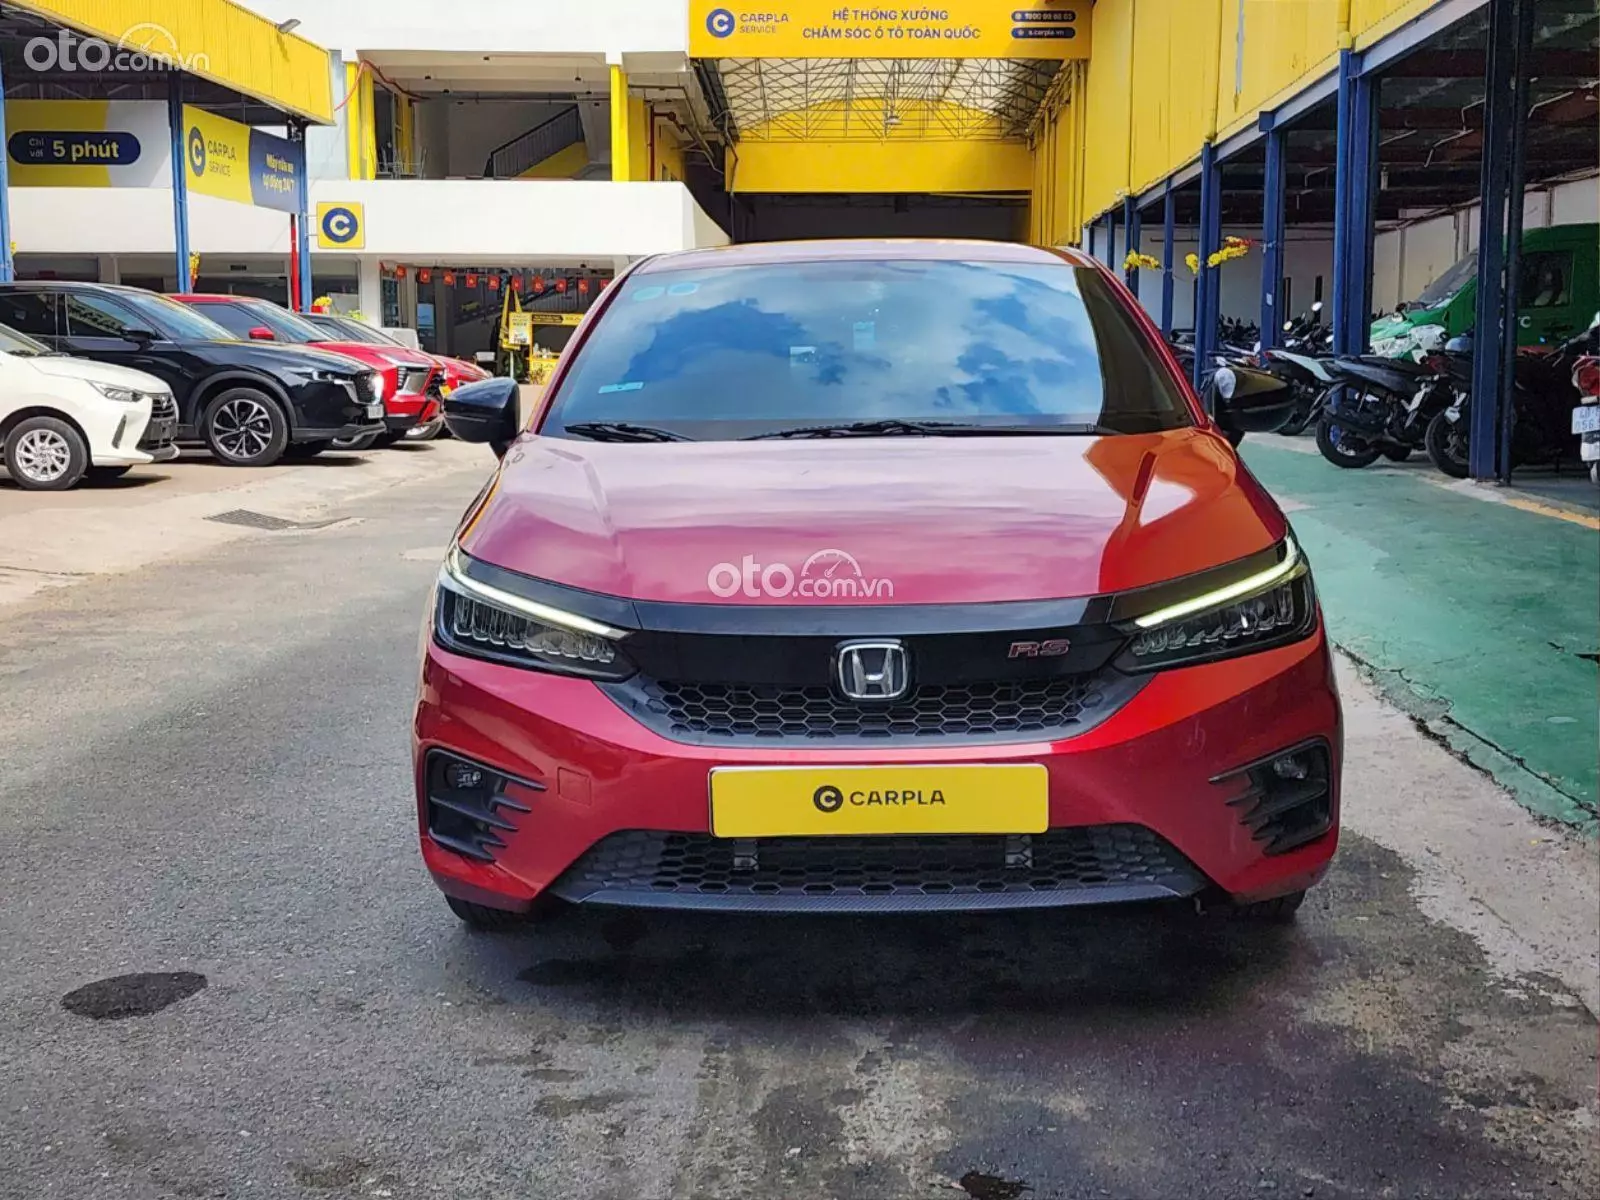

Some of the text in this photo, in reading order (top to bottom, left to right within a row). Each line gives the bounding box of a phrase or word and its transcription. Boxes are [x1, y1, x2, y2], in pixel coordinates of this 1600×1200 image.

[740, 13, 789, 23] CARPLA
[832, 6, 948, 23] HỆ THỐNG XƯỞNG
[740, 25, 777, 34] SERVICE
[803, 25, 842, 39] CHĂM
[845, 25, 871, 39] SÓC
[908, 25, 941, 39] TOÀN
[944, 24, 982, 39] QUỐC
[53, 139, 119, 162] 5 phút
[208, 141, 237, 161] CARPLA
[209, 161, 232, 177] SERVICE
[1008, 638, 1070, 658] RS
[849, 789, 946, 806] CARPLA
